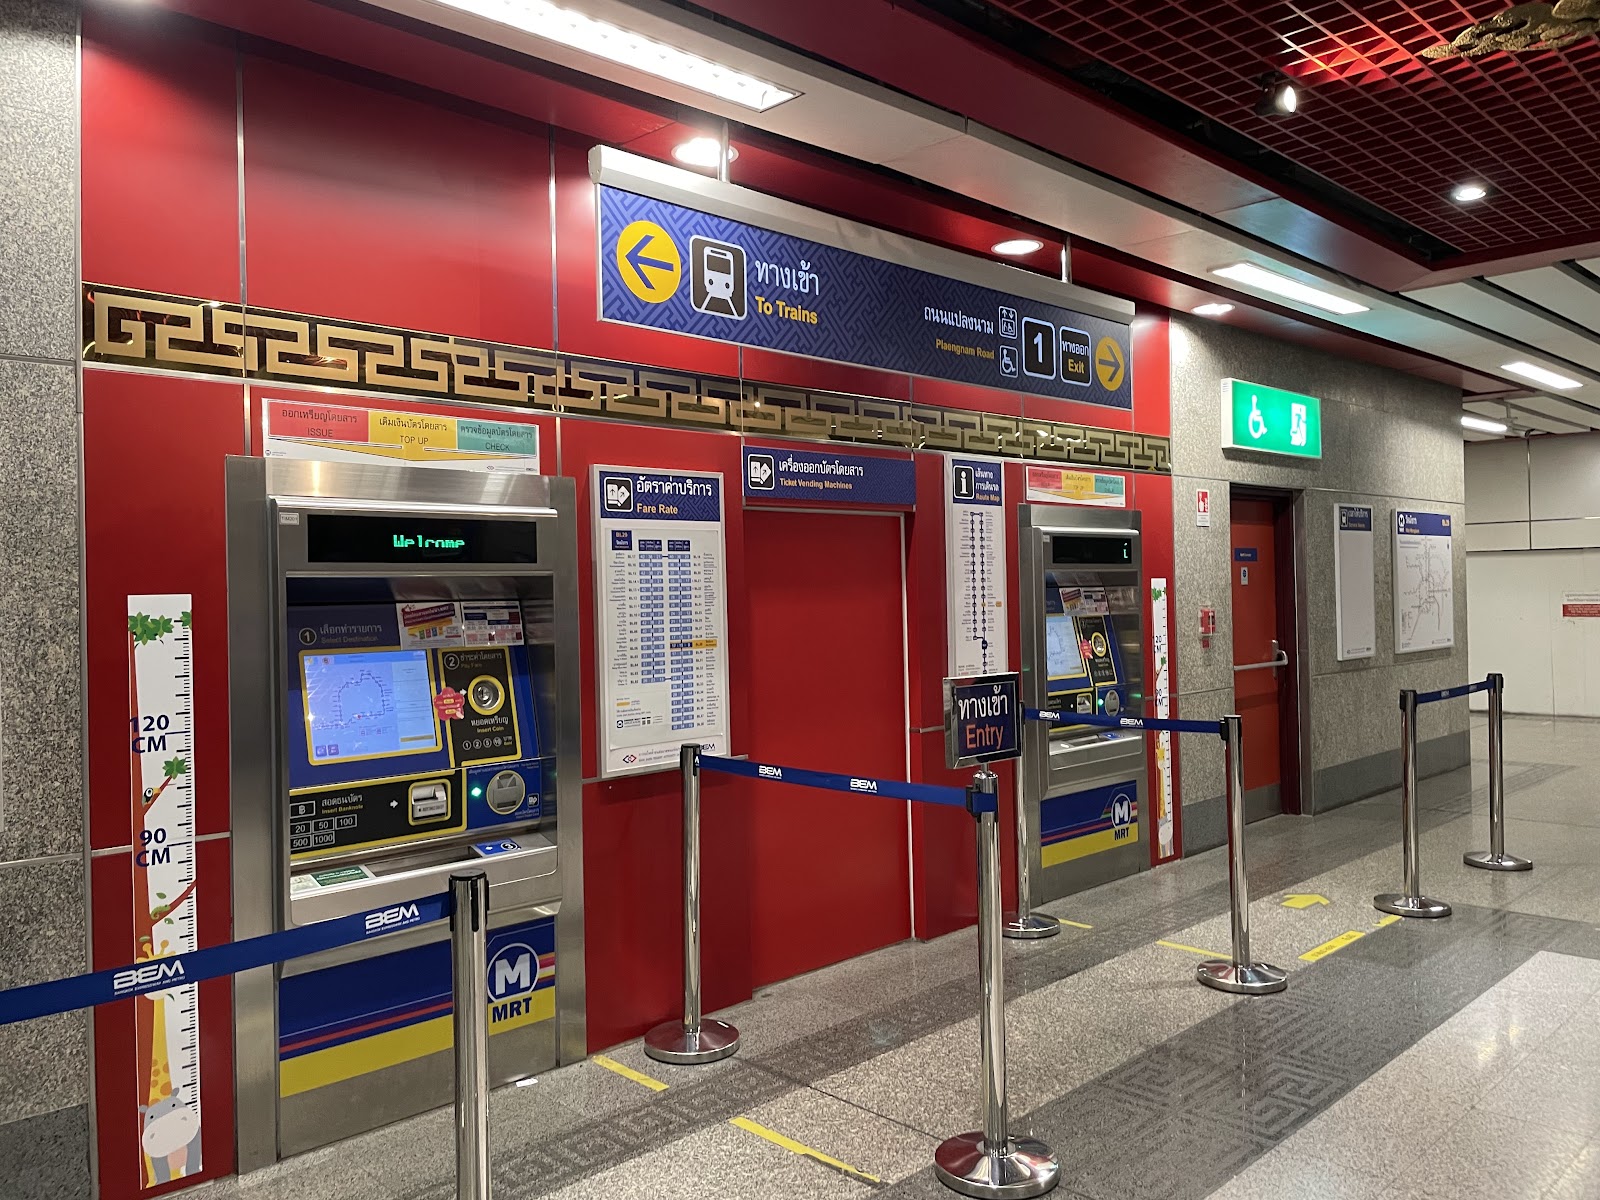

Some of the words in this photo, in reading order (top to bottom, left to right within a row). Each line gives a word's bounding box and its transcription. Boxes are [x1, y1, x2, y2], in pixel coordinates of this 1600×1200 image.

[755, 260, 819, 295] ทางเข้า
[755, 295, 773, 316] To
[776, 300, 818, 325] Trains
[924, 306, 994, 335] ถนนแปลงนาม
[935, 338, 975, 356] Plaengnam
[976, 346, 995, 360] Road
[1033, 332, 1043, 363] 1
[1061, 340, 1089, 356] ทางออก
[1068, 359, 1085, 374] Exit
[282, 409, 357, 423] ออกเหรียญโดยสาร
[307, 428, 333, 438] ISSUE
[399, 435, 416, 444] TOP
[417, 437, 429, 445] UP
[485, 442, 511, 452] CHECK
[778, 454, 864, 477] เครื่องออกบัตรโดยสาร
[636, 476, 712, 496] อัตราค่าบริการ
[779, 478, 798, 487] Ticket
[798, 479, 823, 489] Vending
[824, 481, 853, 490] Machines
[975, 493, 990, 501] Route
[990, 494, 1000, 502] Map
[636, 503, 656, 514] Fare
[658, 504, 678, 515] Rate
[304, 631, 310, 642] 1
[320, 623, 382, 634] เลือกทำรายการ
[449, 657, 456, 667] 2
[958, 685, 1008, 720] ทางเข้า
[1039, 710, 1060, 719] BEM
[1120, 717, 1143, 726] BEM
[130, 714, 170, 733] 120
[132, 735, 166, 754] CM
[966, 723, 1004, 750] Entry
[759, 765, 782, 778] BEM
[850, 778, 878, 791] BEM
[338, 804, 364, 813] Banknote
[1115, 801, 1129, 824] M
[295, 825, 306, 834] 20
[318, 821, 329, 830] 50
[339, 817, 354, 826] 100
[139, 828, 167, 847] 90
[292, 837, 309, 848] 500
[315, 833, 334, 844] 1000
[1114, 827, 1130, 841] MRT
[135, 848, 171, 868] CM
[365, 903, 420, 930] BEM
[113, 959, 185, 990] BEM
[495, 952, 531, 996] M
[492, 996, 533, 1024] MRT
